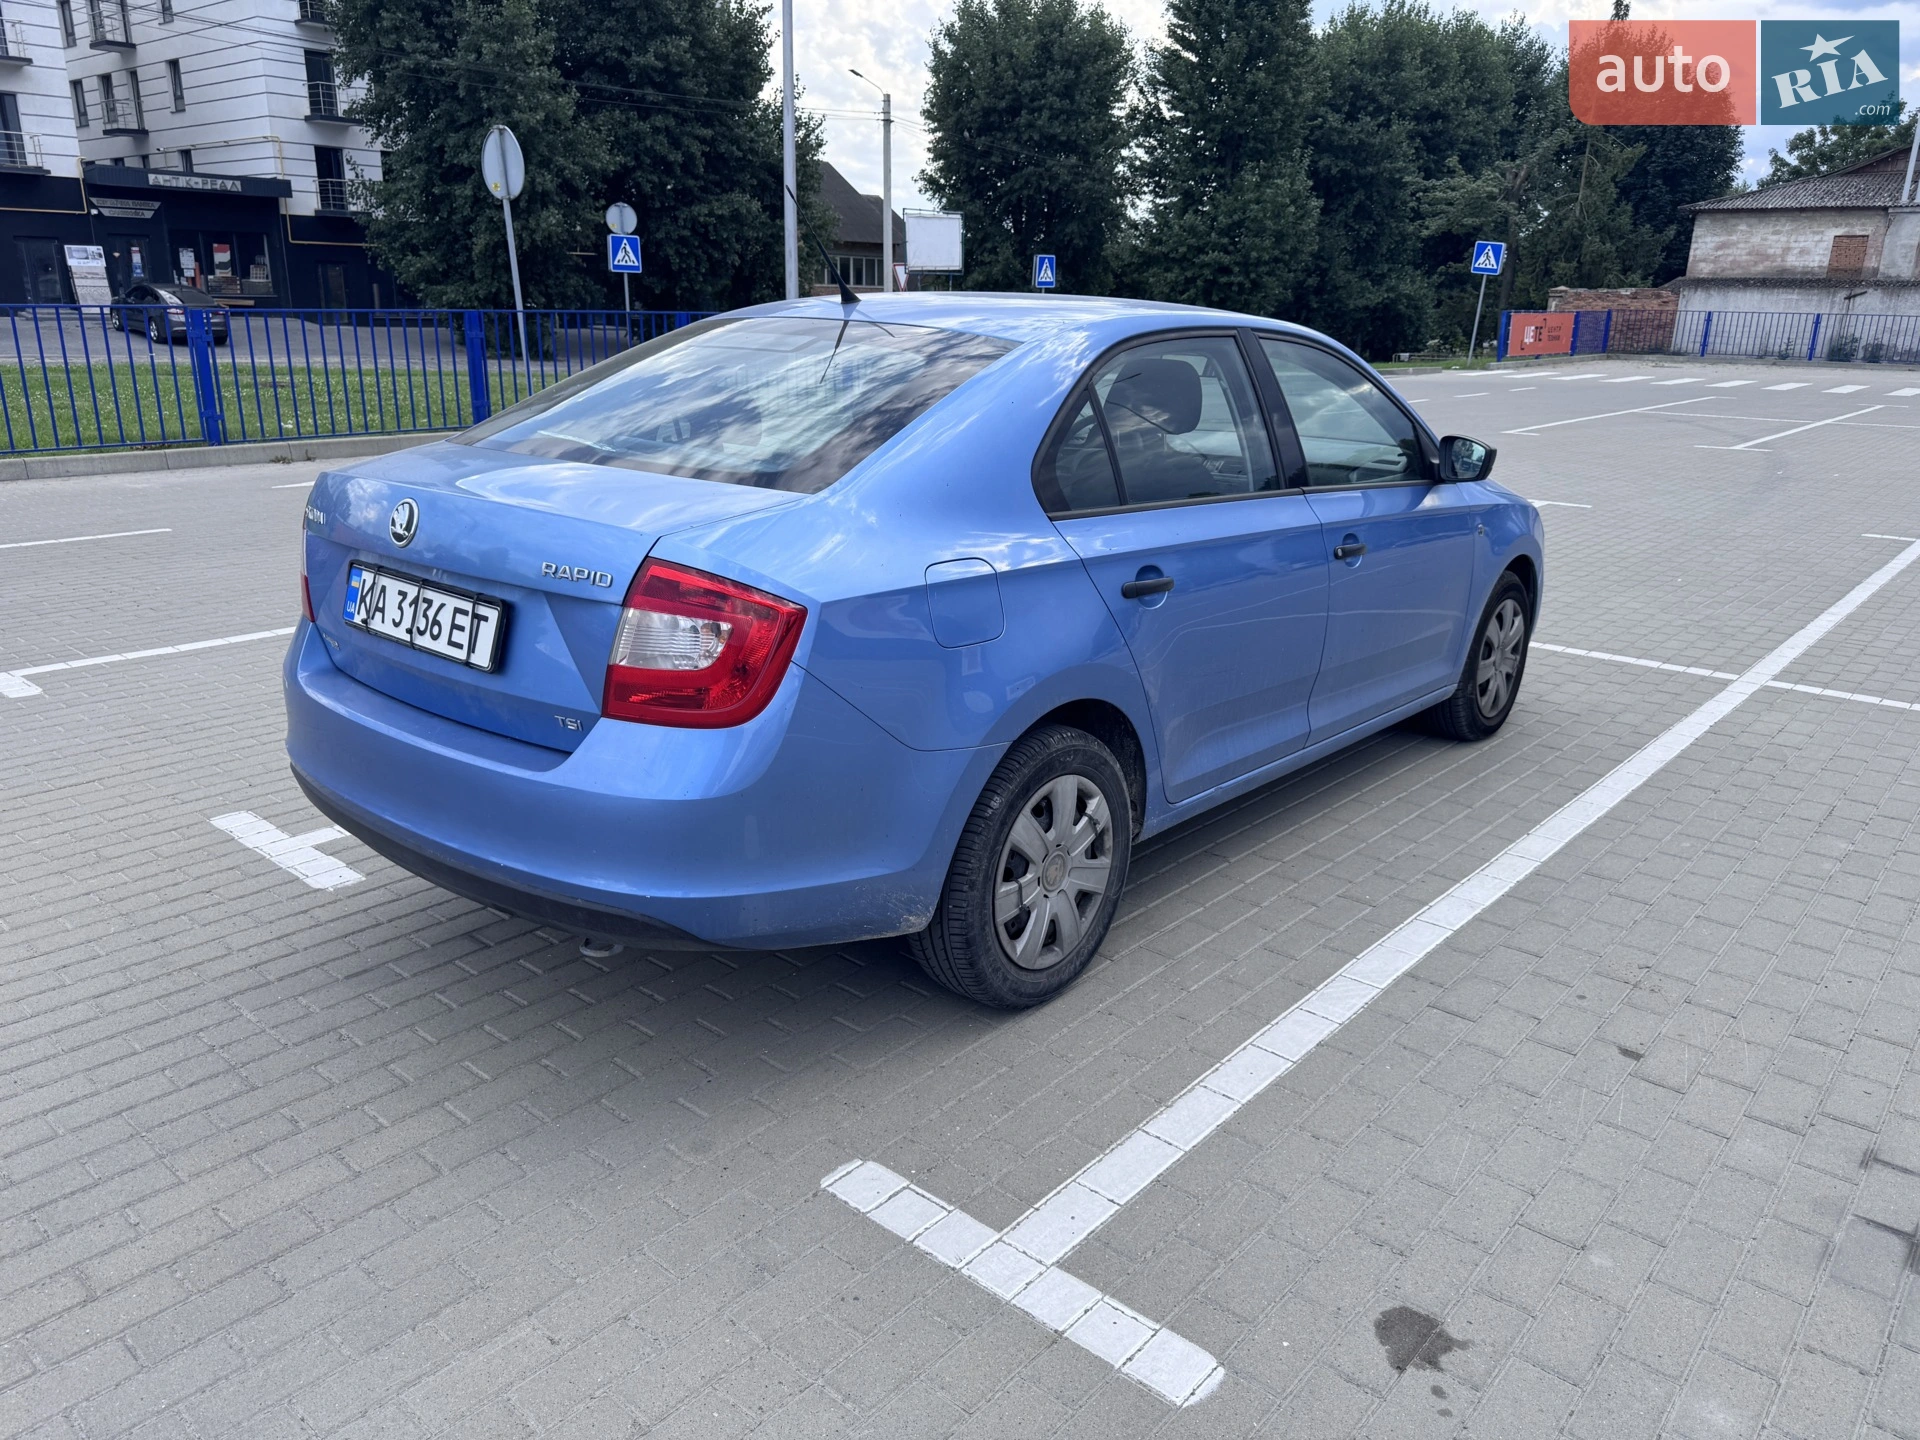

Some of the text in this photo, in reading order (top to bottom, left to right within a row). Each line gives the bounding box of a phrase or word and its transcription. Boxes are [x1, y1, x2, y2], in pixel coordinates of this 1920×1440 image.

[541, 561, 613, 588] RAPID
[346, 602, 355, 613] UA
[447, 606, 489, 654] ET
